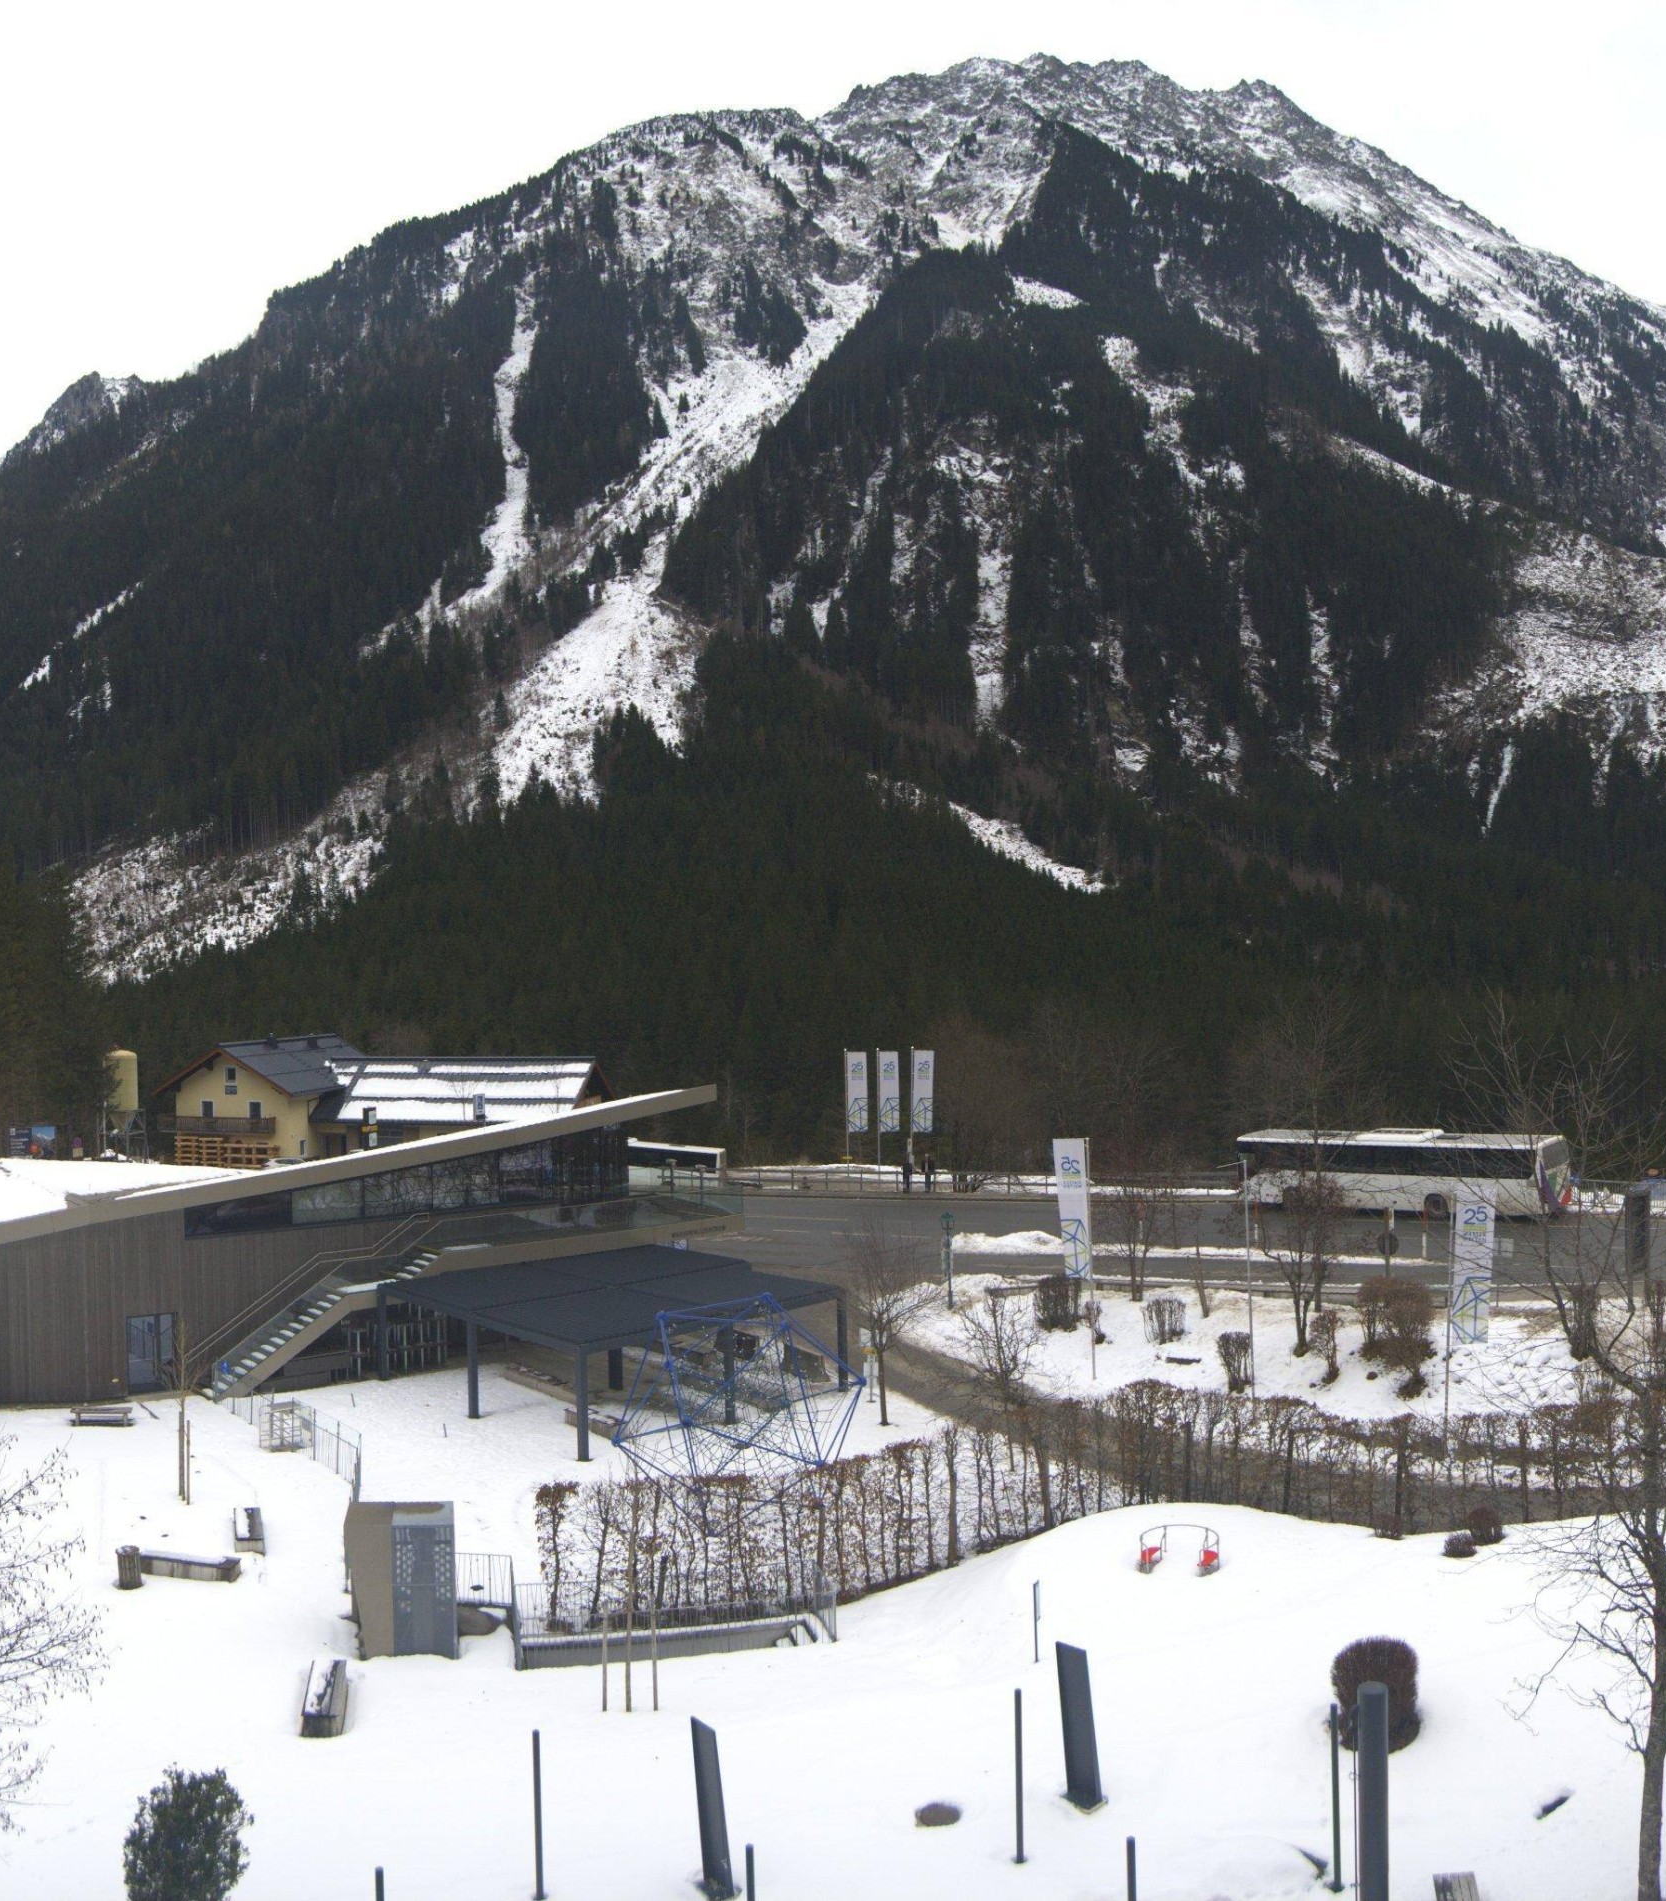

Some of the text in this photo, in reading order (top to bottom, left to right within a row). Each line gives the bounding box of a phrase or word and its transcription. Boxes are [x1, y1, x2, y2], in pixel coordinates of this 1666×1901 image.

[851, 1062, 864, 1073] 25
[883, 1061, 896, 1072] 25
[918, 1060, 931, 1071] 25
[1463, 1206, 1488, 1225] 25
